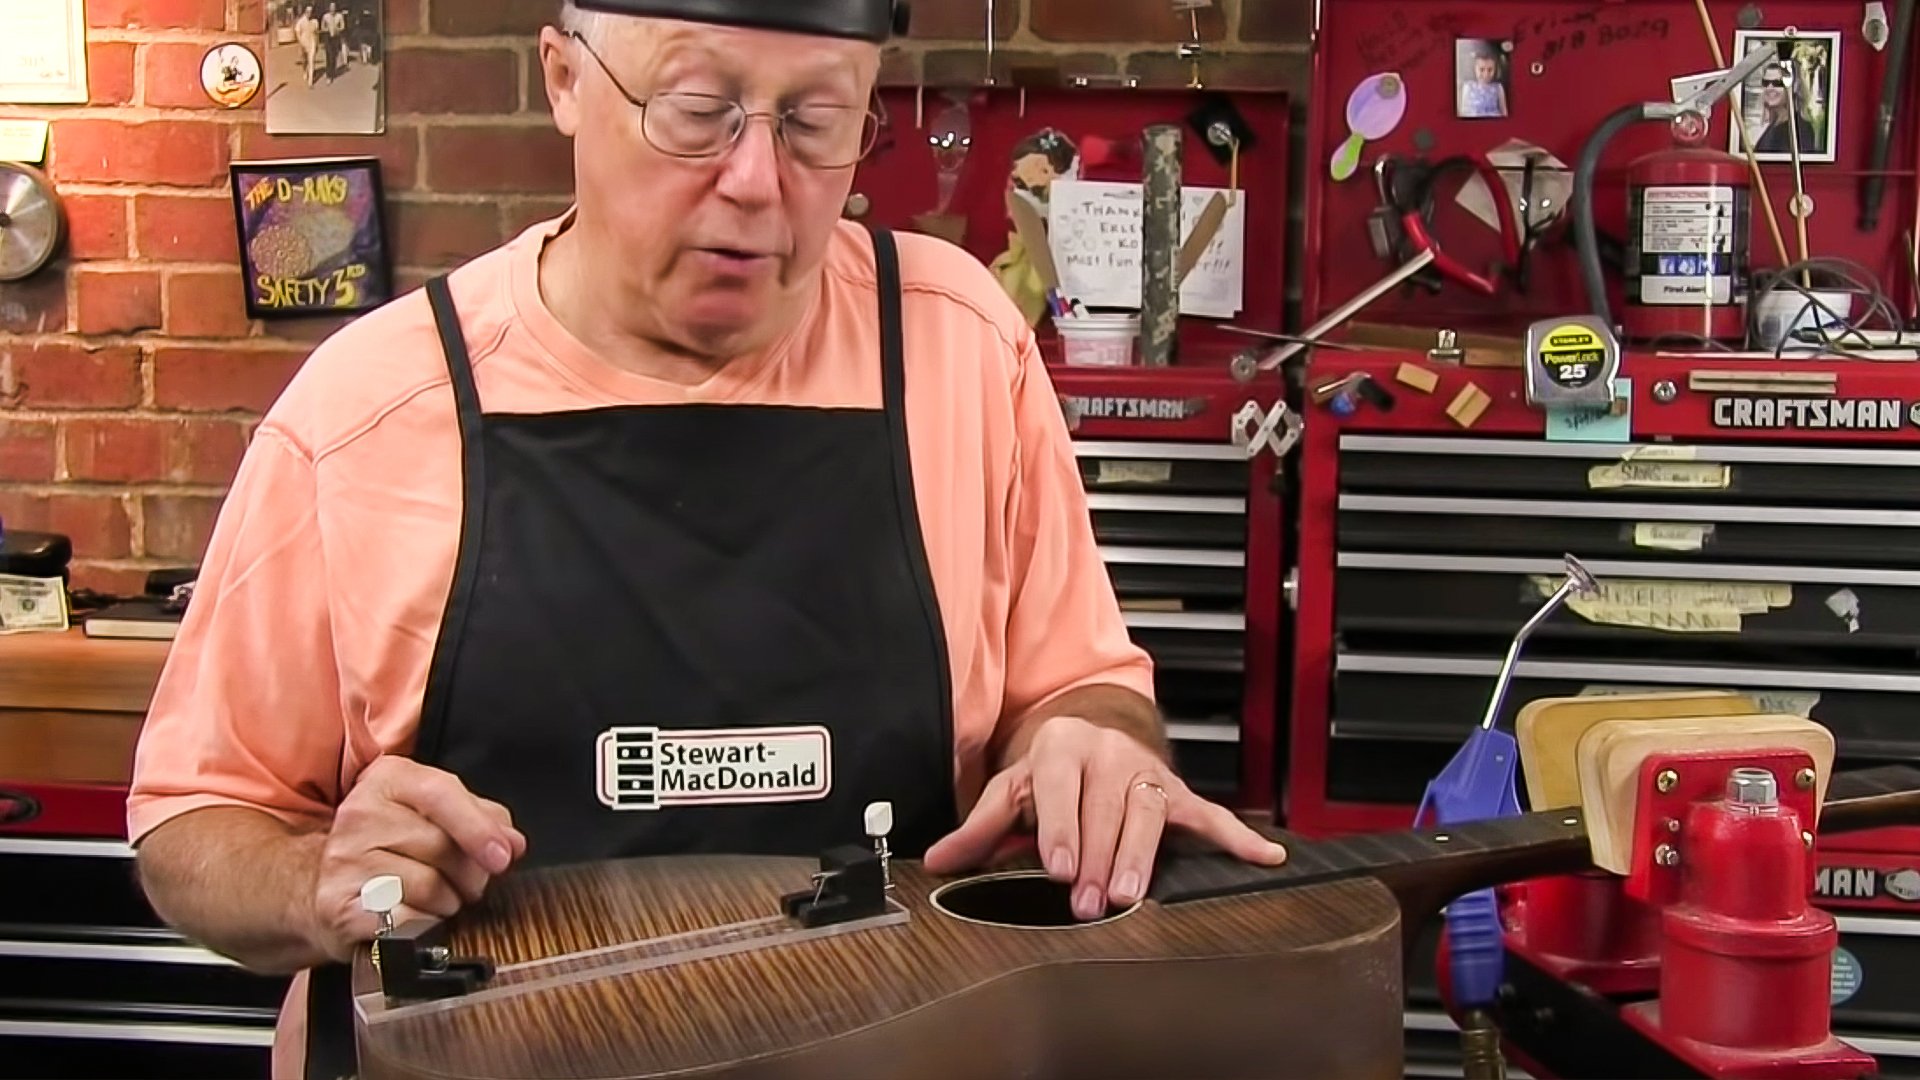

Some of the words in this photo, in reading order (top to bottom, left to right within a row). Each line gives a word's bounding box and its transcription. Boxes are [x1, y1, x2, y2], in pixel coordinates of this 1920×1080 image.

[244, 176, 275, 210] THE
[257, 274, 330, 308] SAFETY
[1544, 351, 1600, 365] PowerLock
[1066, 396, 1184, 419] RAFTSMAN
[1713, 397, 1901, 428] CRAFTSMAN
[660, 742, 776, 766] Stewart-
[660, 762, 817, 791] MacDonald
